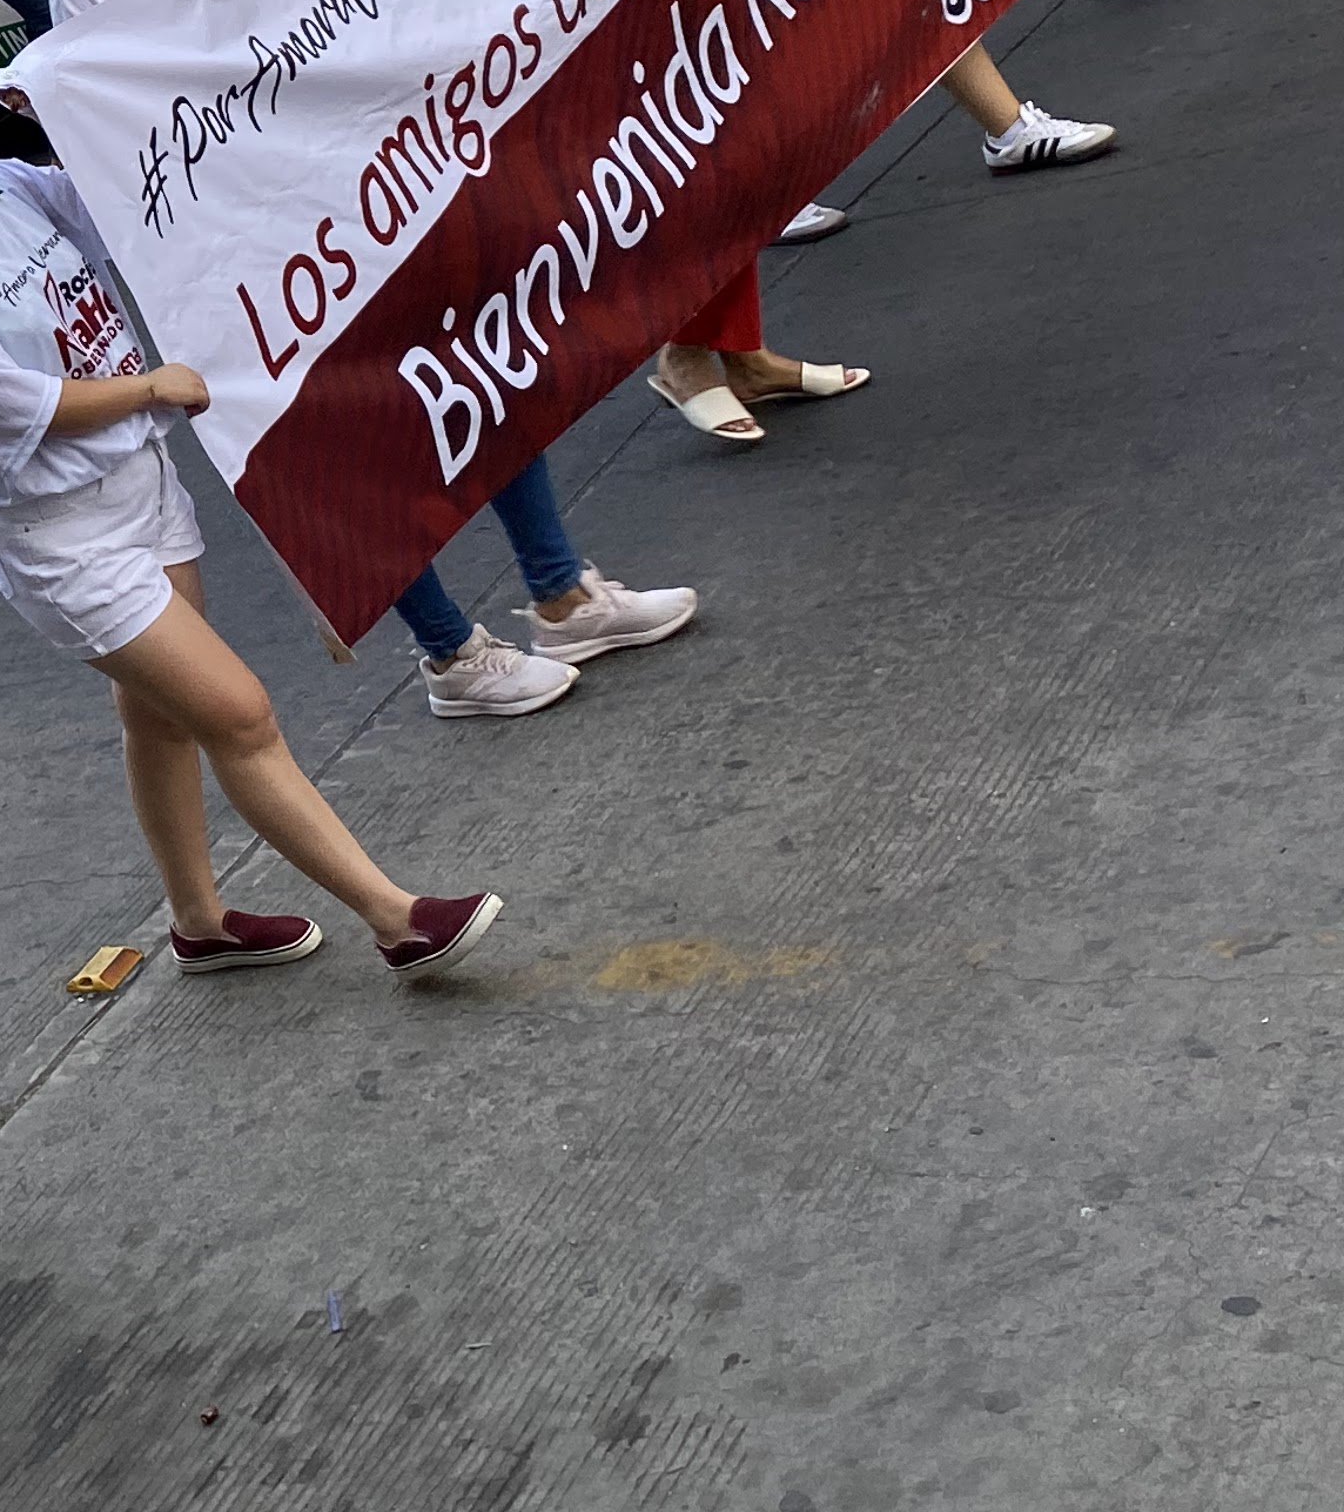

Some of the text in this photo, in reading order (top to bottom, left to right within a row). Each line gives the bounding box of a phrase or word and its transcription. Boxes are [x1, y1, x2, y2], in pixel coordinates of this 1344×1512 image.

[236, 216, 357, 381] Los
[359, 3, 541, 246] amigos
[398, 1, 750, 486] Bienvenida
